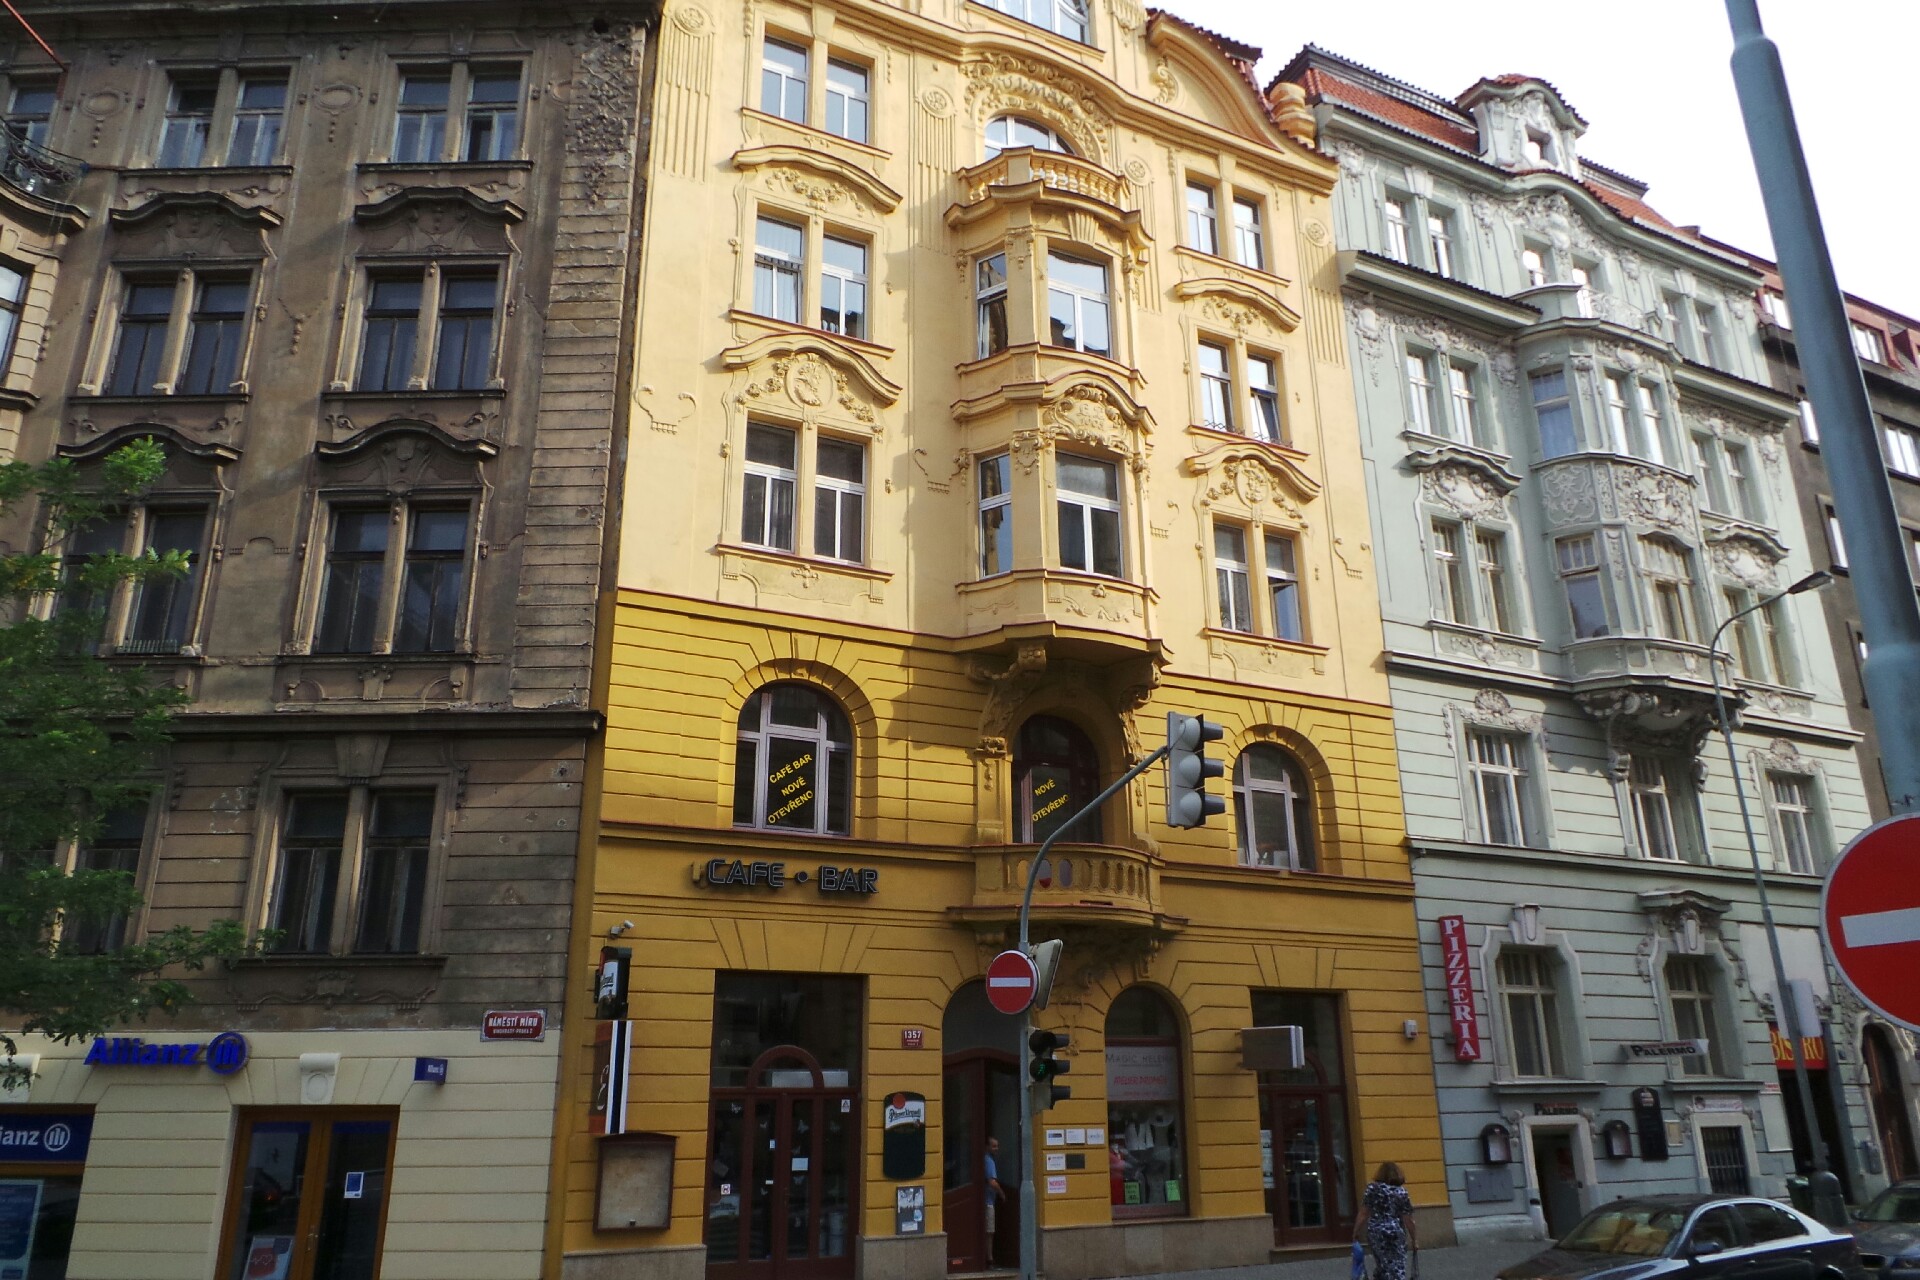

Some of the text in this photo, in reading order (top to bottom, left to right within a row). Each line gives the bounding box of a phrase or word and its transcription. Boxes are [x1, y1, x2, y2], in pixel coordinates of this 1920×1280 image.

[793, 754, 812, 769] BAR
[768, 790, 814, 824] OTEVŘENO
[707, 858, 879, 894] CAFE BAR
[1443, 919, 1476, 1056] PIZZERIA
[904, 1030, 921, 1039] 1357
[1770, 1032, 1824, 1061] BISRO
[84, 1038, 201, 1065] Allianz
[1630, 1044, 1696, 1056] PALERMO
